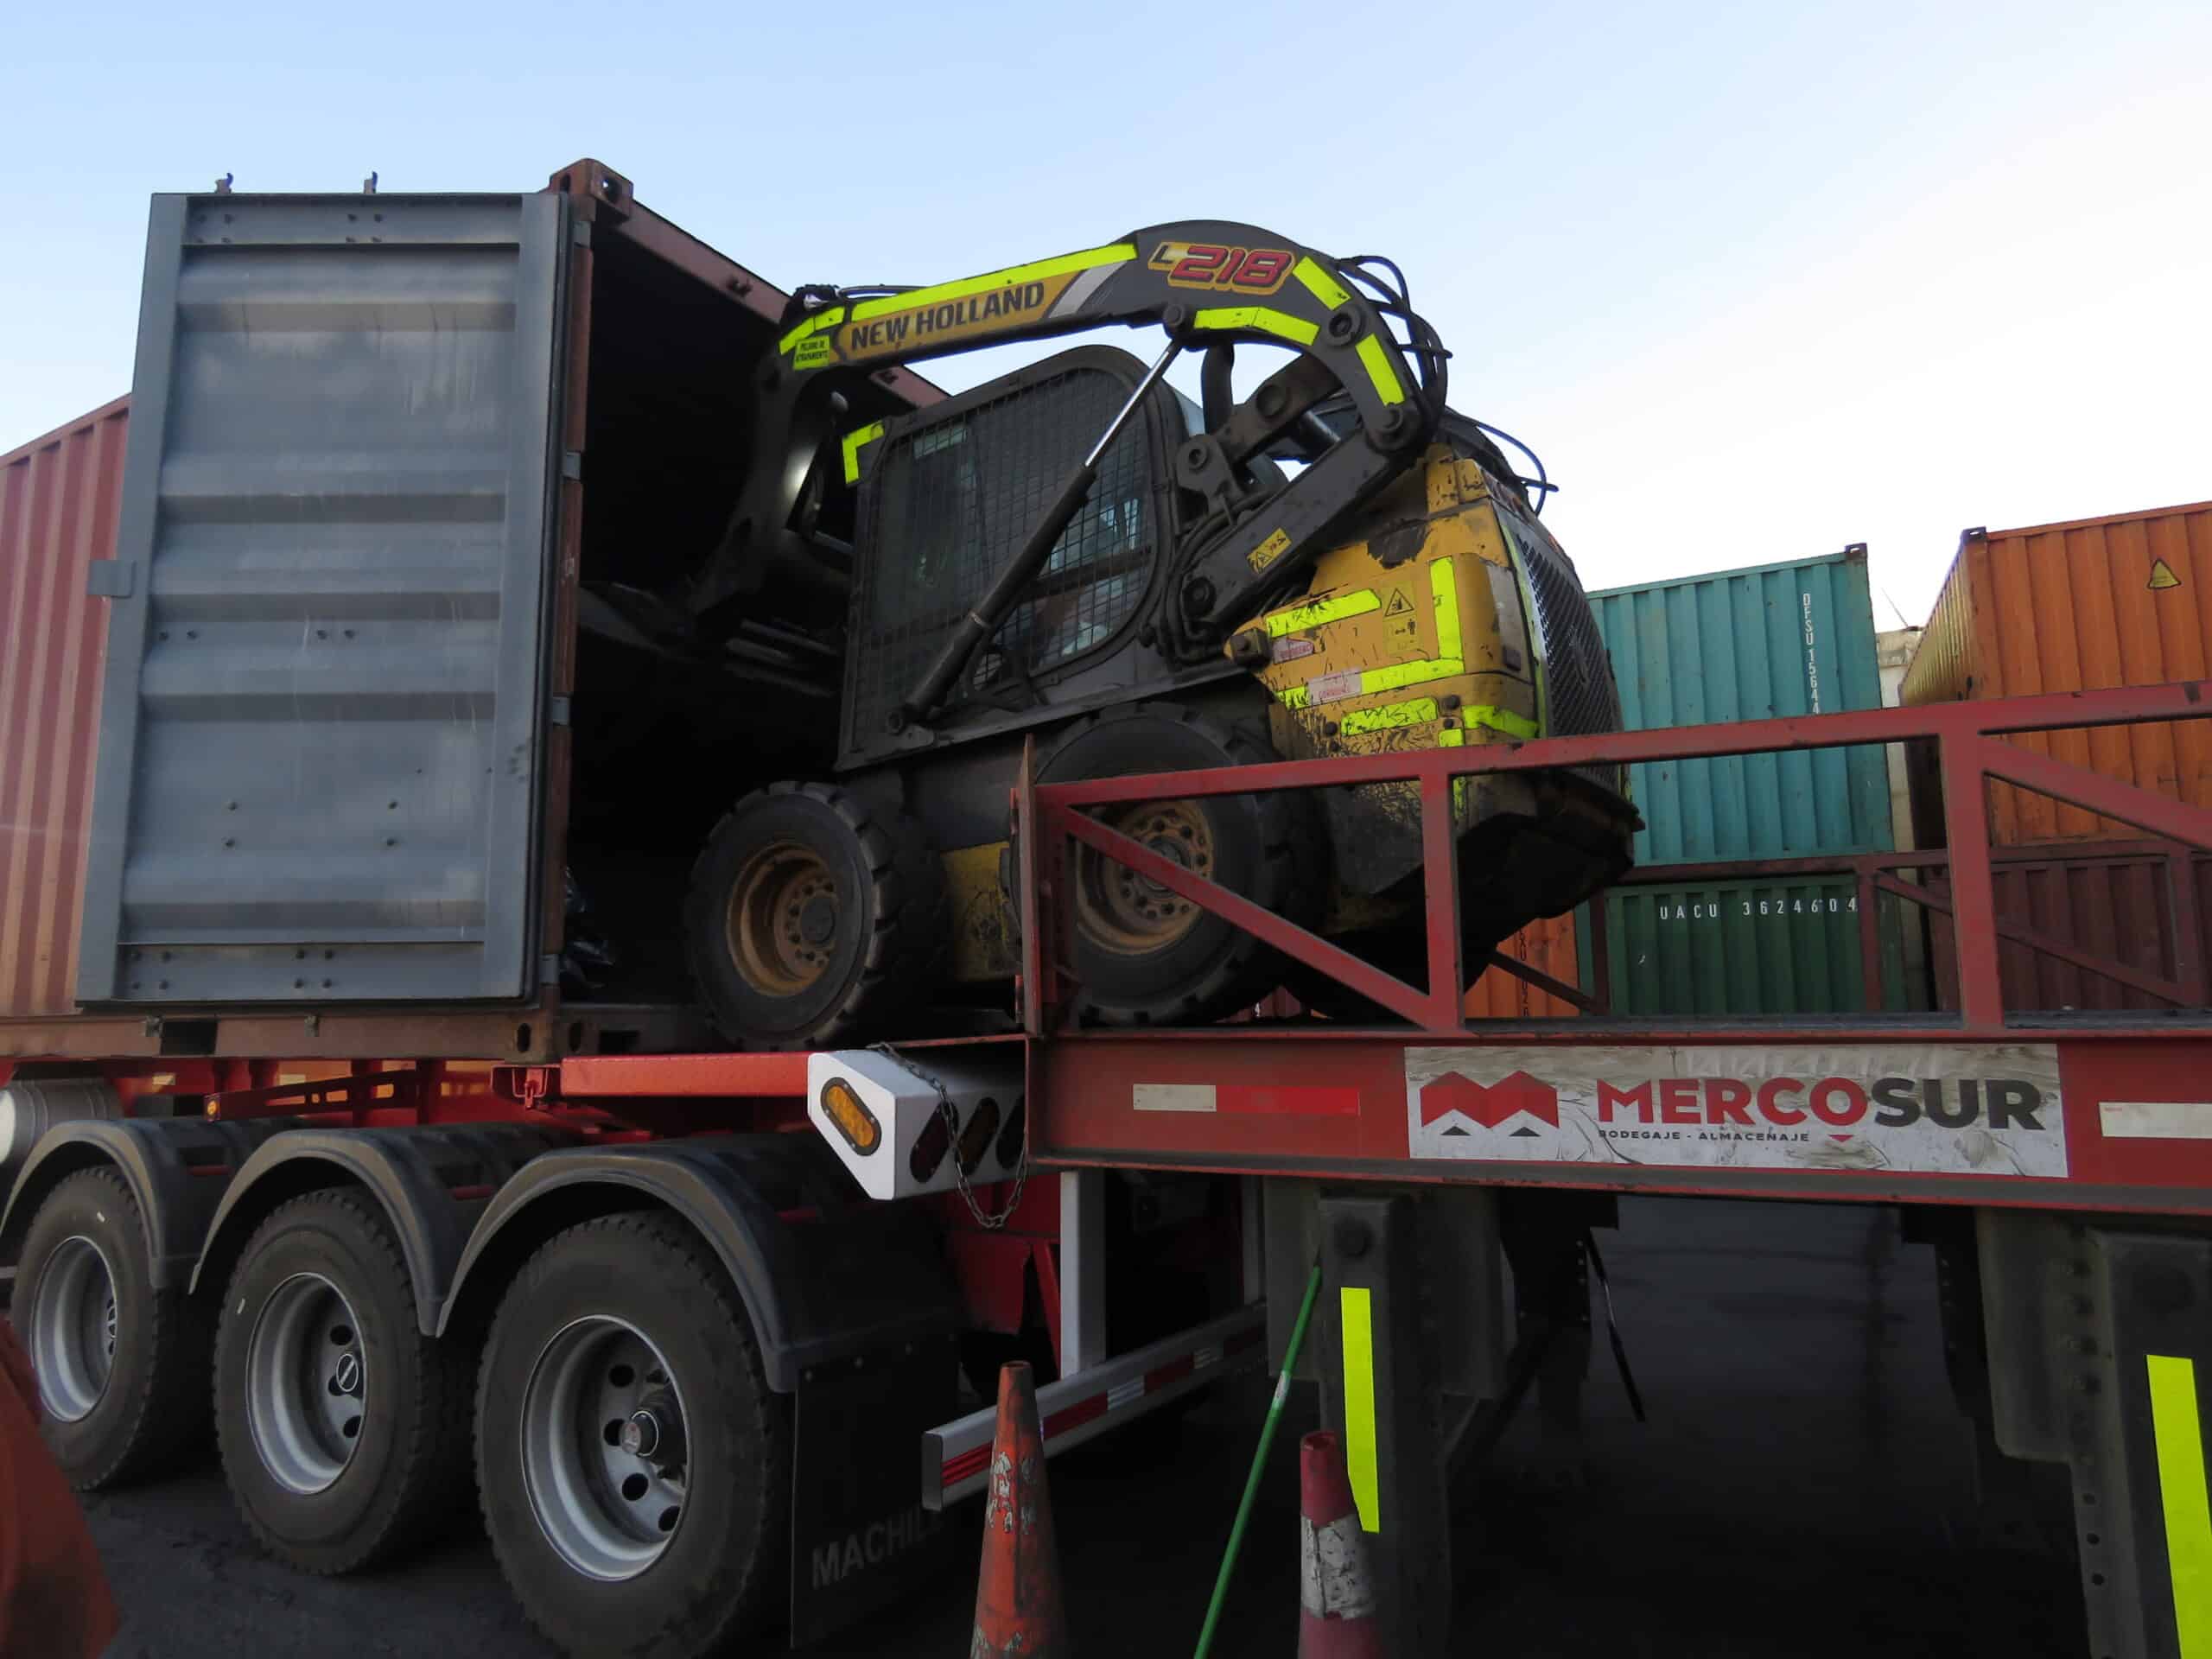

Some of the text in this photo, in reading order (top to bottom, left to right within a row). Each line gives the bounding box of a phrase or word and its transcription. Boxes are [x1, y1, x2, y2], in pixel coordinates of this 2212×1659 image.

[850, 282, 1045, 351] NEW HOLLAND
[1659, 903, 1718, 920] UACU
[1597, 1077, 2046, 1131] MERCOSUR
[1599, 1130, 1681, 1141] BODEGAJE
[1699, 1131, 1810, 1142] ALMACENAJE
